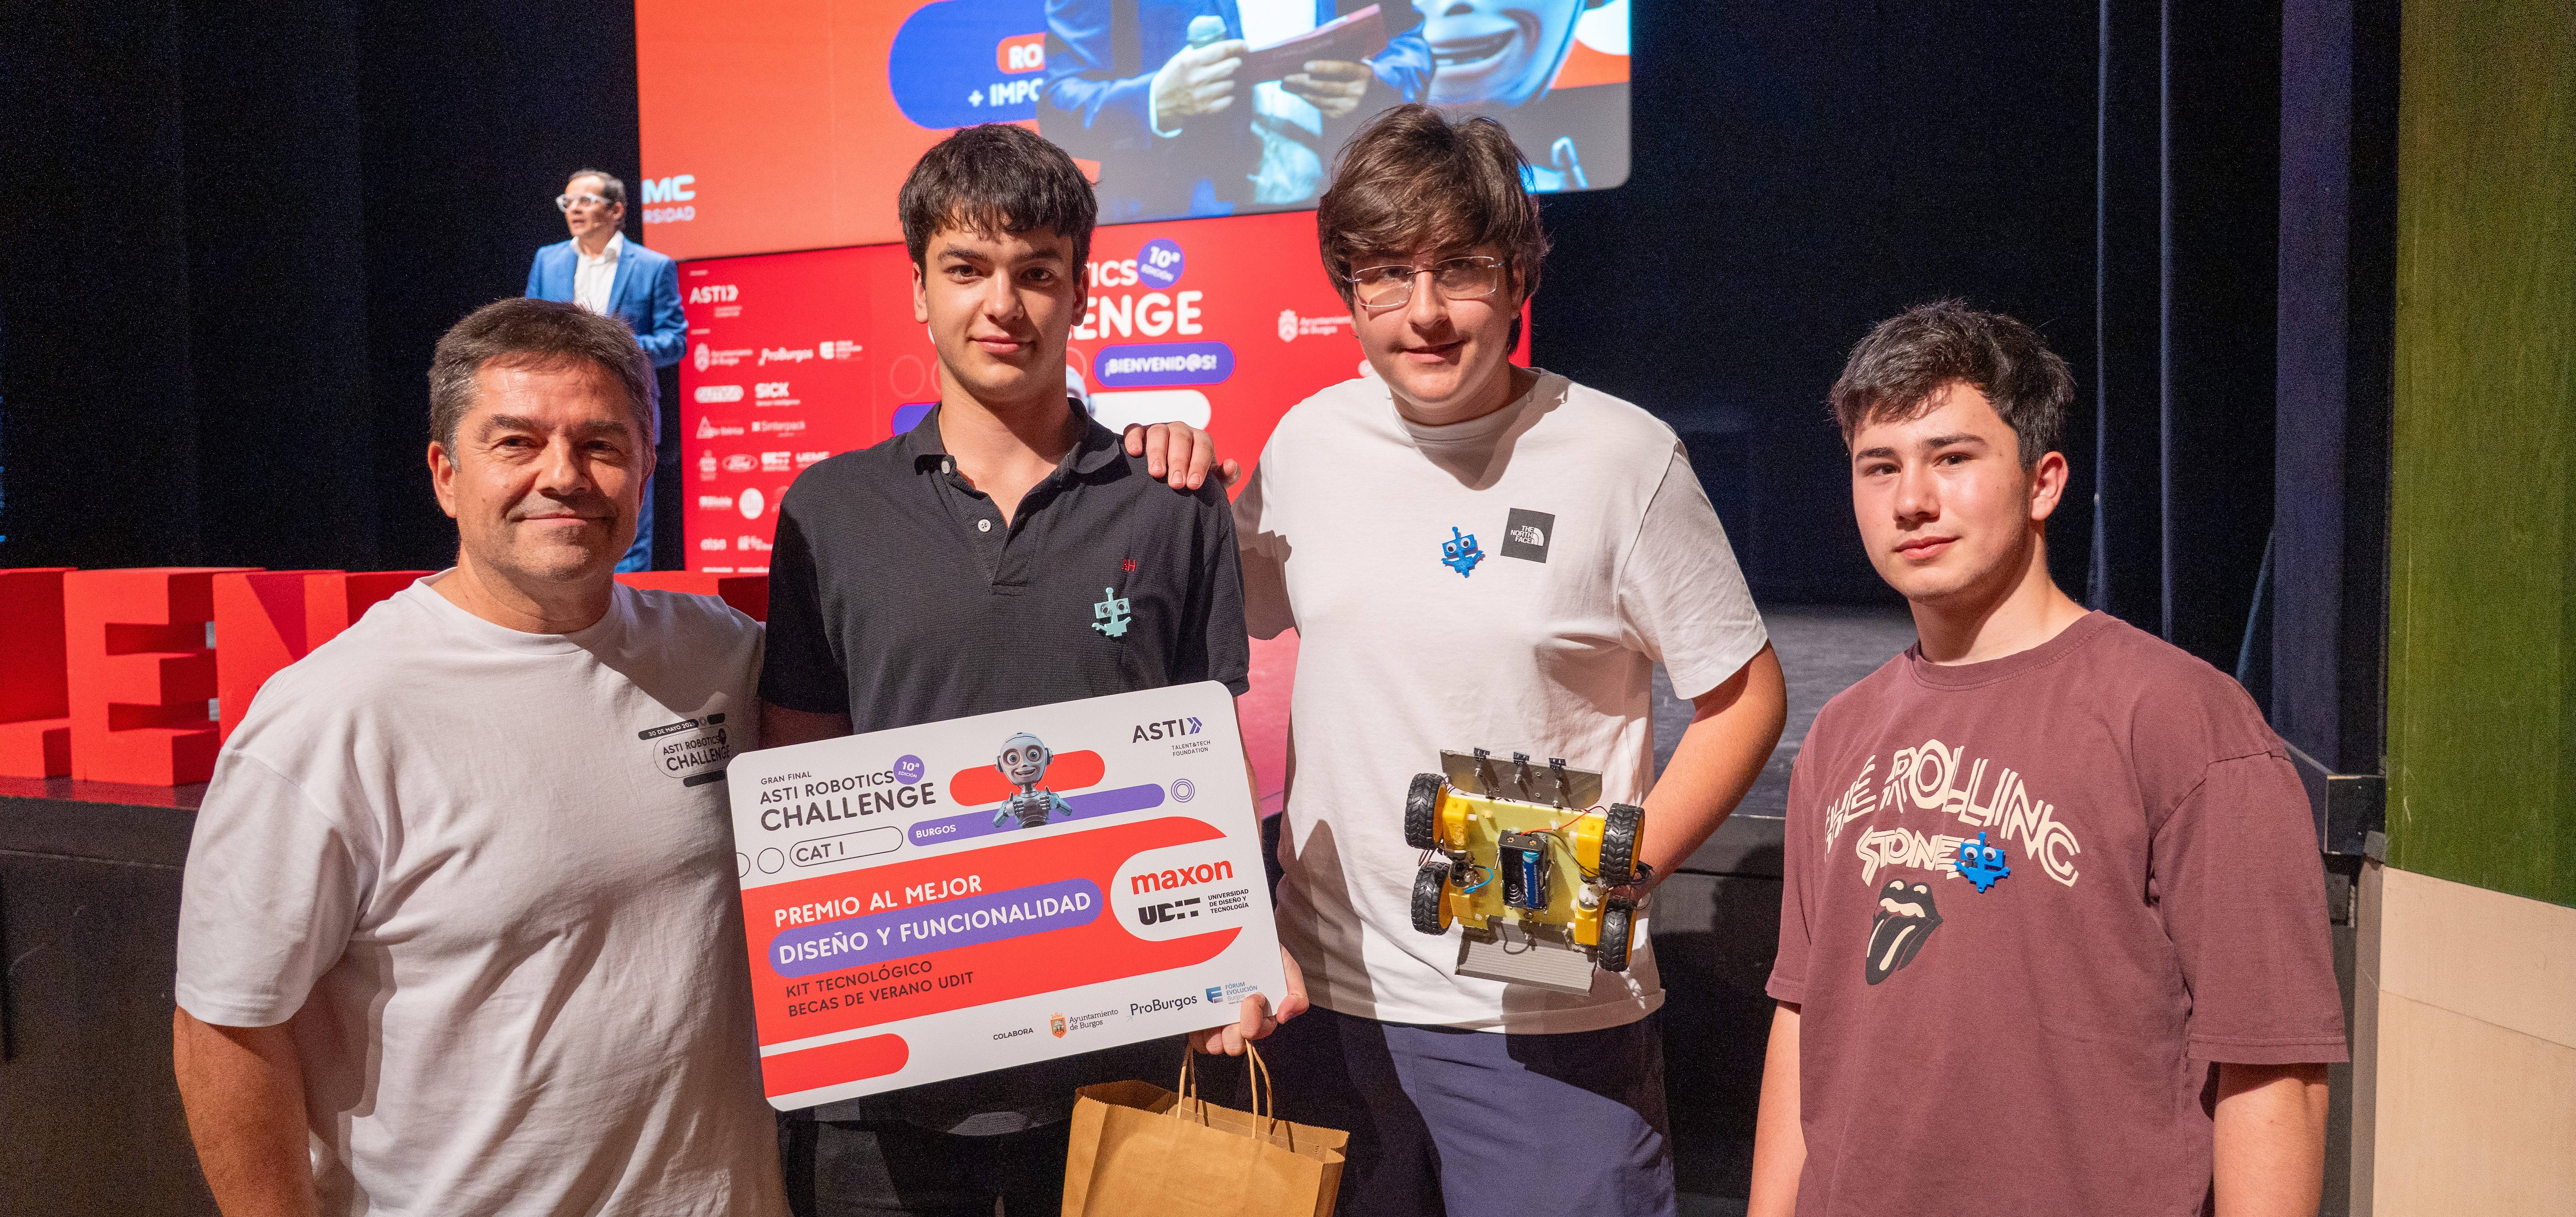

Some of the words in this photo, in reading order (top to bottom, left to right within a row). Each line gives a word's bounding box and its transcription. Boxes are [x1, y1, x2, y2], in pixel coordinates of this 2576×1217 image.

[1009, 43, 1043, 69] RO
[641, 175, 696, 205] MC
[1085, 259, 1139, 288] ICS
[689, 285, 727, 304] ASTI
[1067, 290, 1203, 341] ENGE
[755, 382, 789, 398] SICK
[1510, 529, 1532, 538] NORTH
[1521, 525, 1534, 533] THE
[1515, 536, 1531, 544] FACE
[0, 568, 347, 787] EN
[665, 725, 681, 734] MAYO
[1133, 718, 1185, 743] ASTI
[663, 743, 683, 756] ASTI
[685, 735, 719, 750] ROBOTICS
[1171, 739, 1211, 750] TALENT&TECH
[1173, 746, 1209, 757] FOUNDATION
[666, 744, 730, 771] CHALLENGE
[902, 761, 920, 771] 10ª
[760, 787, 798, 805] ASTI
[806, 770, 895, 797] ROBOTICS
[761, 774, 785, 785] GRAN
[788, 771, 812, 781] FINAL
[761, 782, 937, 831] CHALLENGE
[1879, 739, 2081, 887] ROLLING
[915, 824, 956, 839] BURGOS
[796, 843, 830, 862] CAT
[1131, 860, 1233, 895] maxon
[774, 896, 860, 927] PREMIO
[869, 890, 898, 911] AL
[905, 874, 983, 905] MEJOR
[1208, 888, 1249, 900] UNIVERSIDAD
[1219, 897, 1241, 906] DISEÑO
[1210, 902, 1249, 914] TECNOLOGÍA
[779, 928, 869, 965] DISEÑO
[877, 927, 892, 946] Y
[899, 892, 1091, 942] FUNCIONALIDAD
[786, 981, 811, 998] KIT
[816, 960, 933, 992] TECNOLÓGICO
[1225, 981, 1245, 990] FÓRUM
[788, 996, 839, 1017] BECAS
[845, 991, 865, 1007] DE
[869, 979, 933, 1002] VERANO
[938, 971, 974, 989] UDIT
[1226, 985, 1257, 995] EVOLUCIÓN
[1130, 995, 1198, 1016] ProBurgos
[1069, 1009, 1118, 1024] Ayuntamiento
[1080, 1019, 1103, 1031] Burgos
[993, 1028, 1034, 1040] COLABORA
